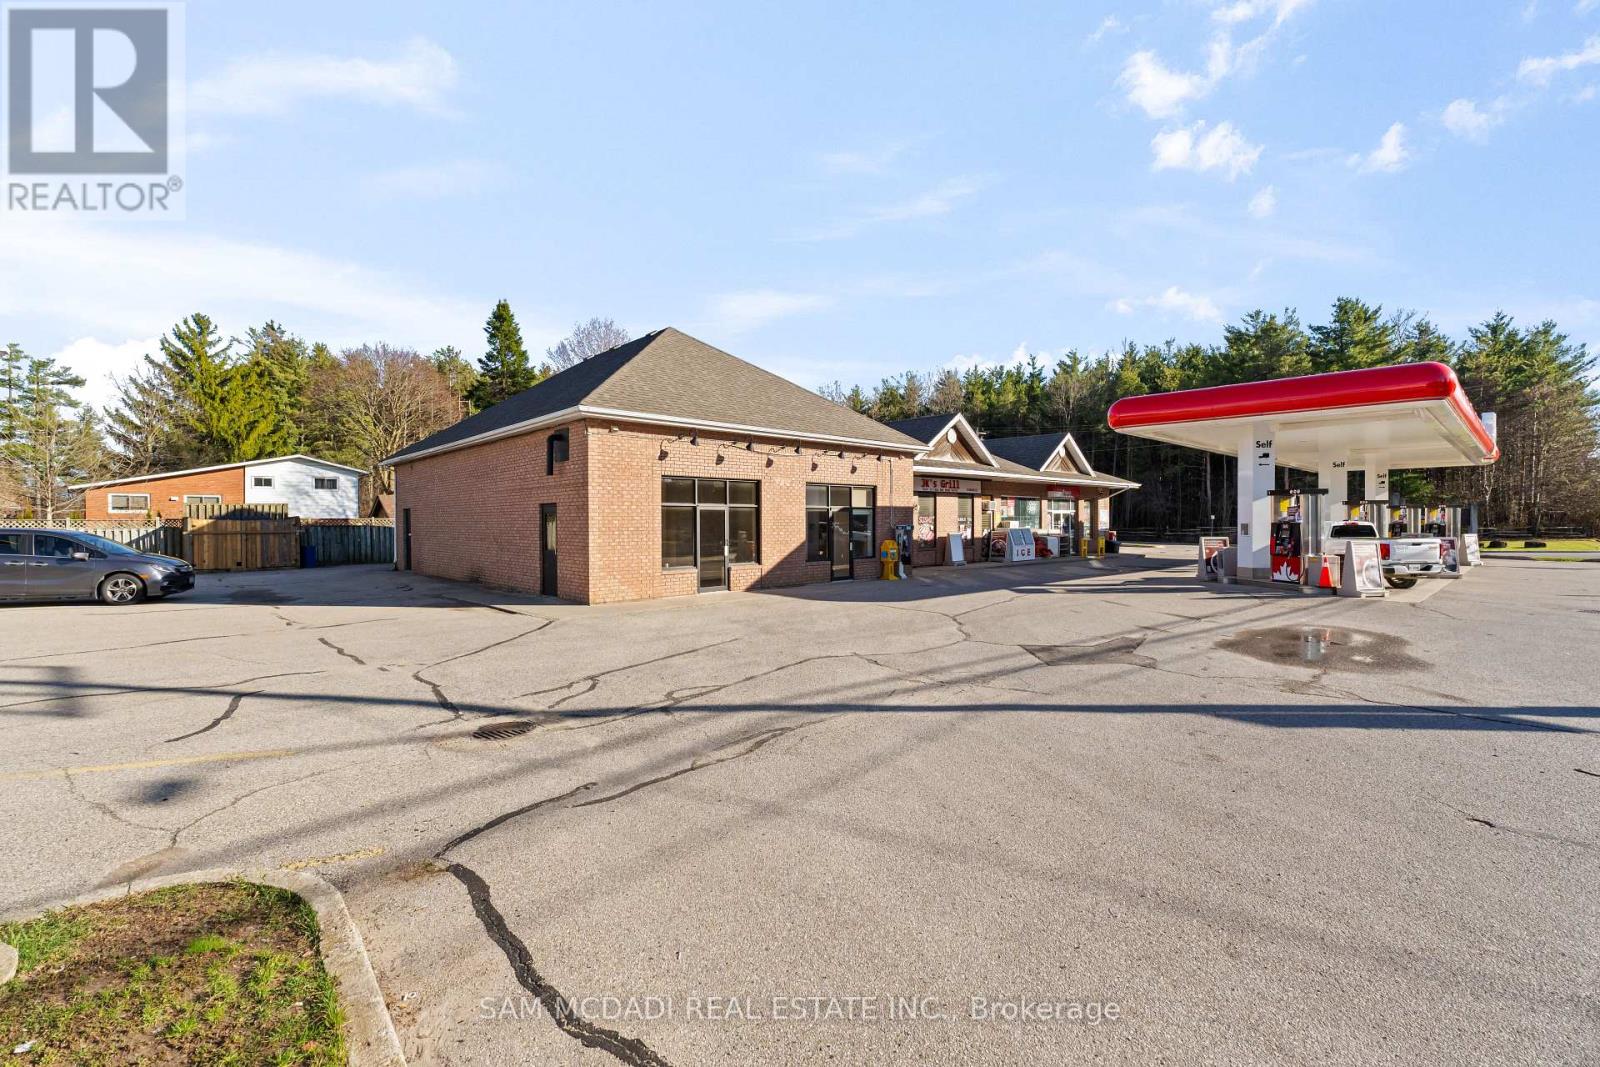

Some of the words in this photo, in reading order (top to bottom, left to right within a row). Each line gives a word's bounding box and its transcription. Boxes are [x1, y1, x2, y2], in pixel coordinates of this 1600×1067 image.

[1256, 440, 1272, 449] Self
[941, 479, 960, 489] Grill
[1016, 548, 1031, 557] ICE
